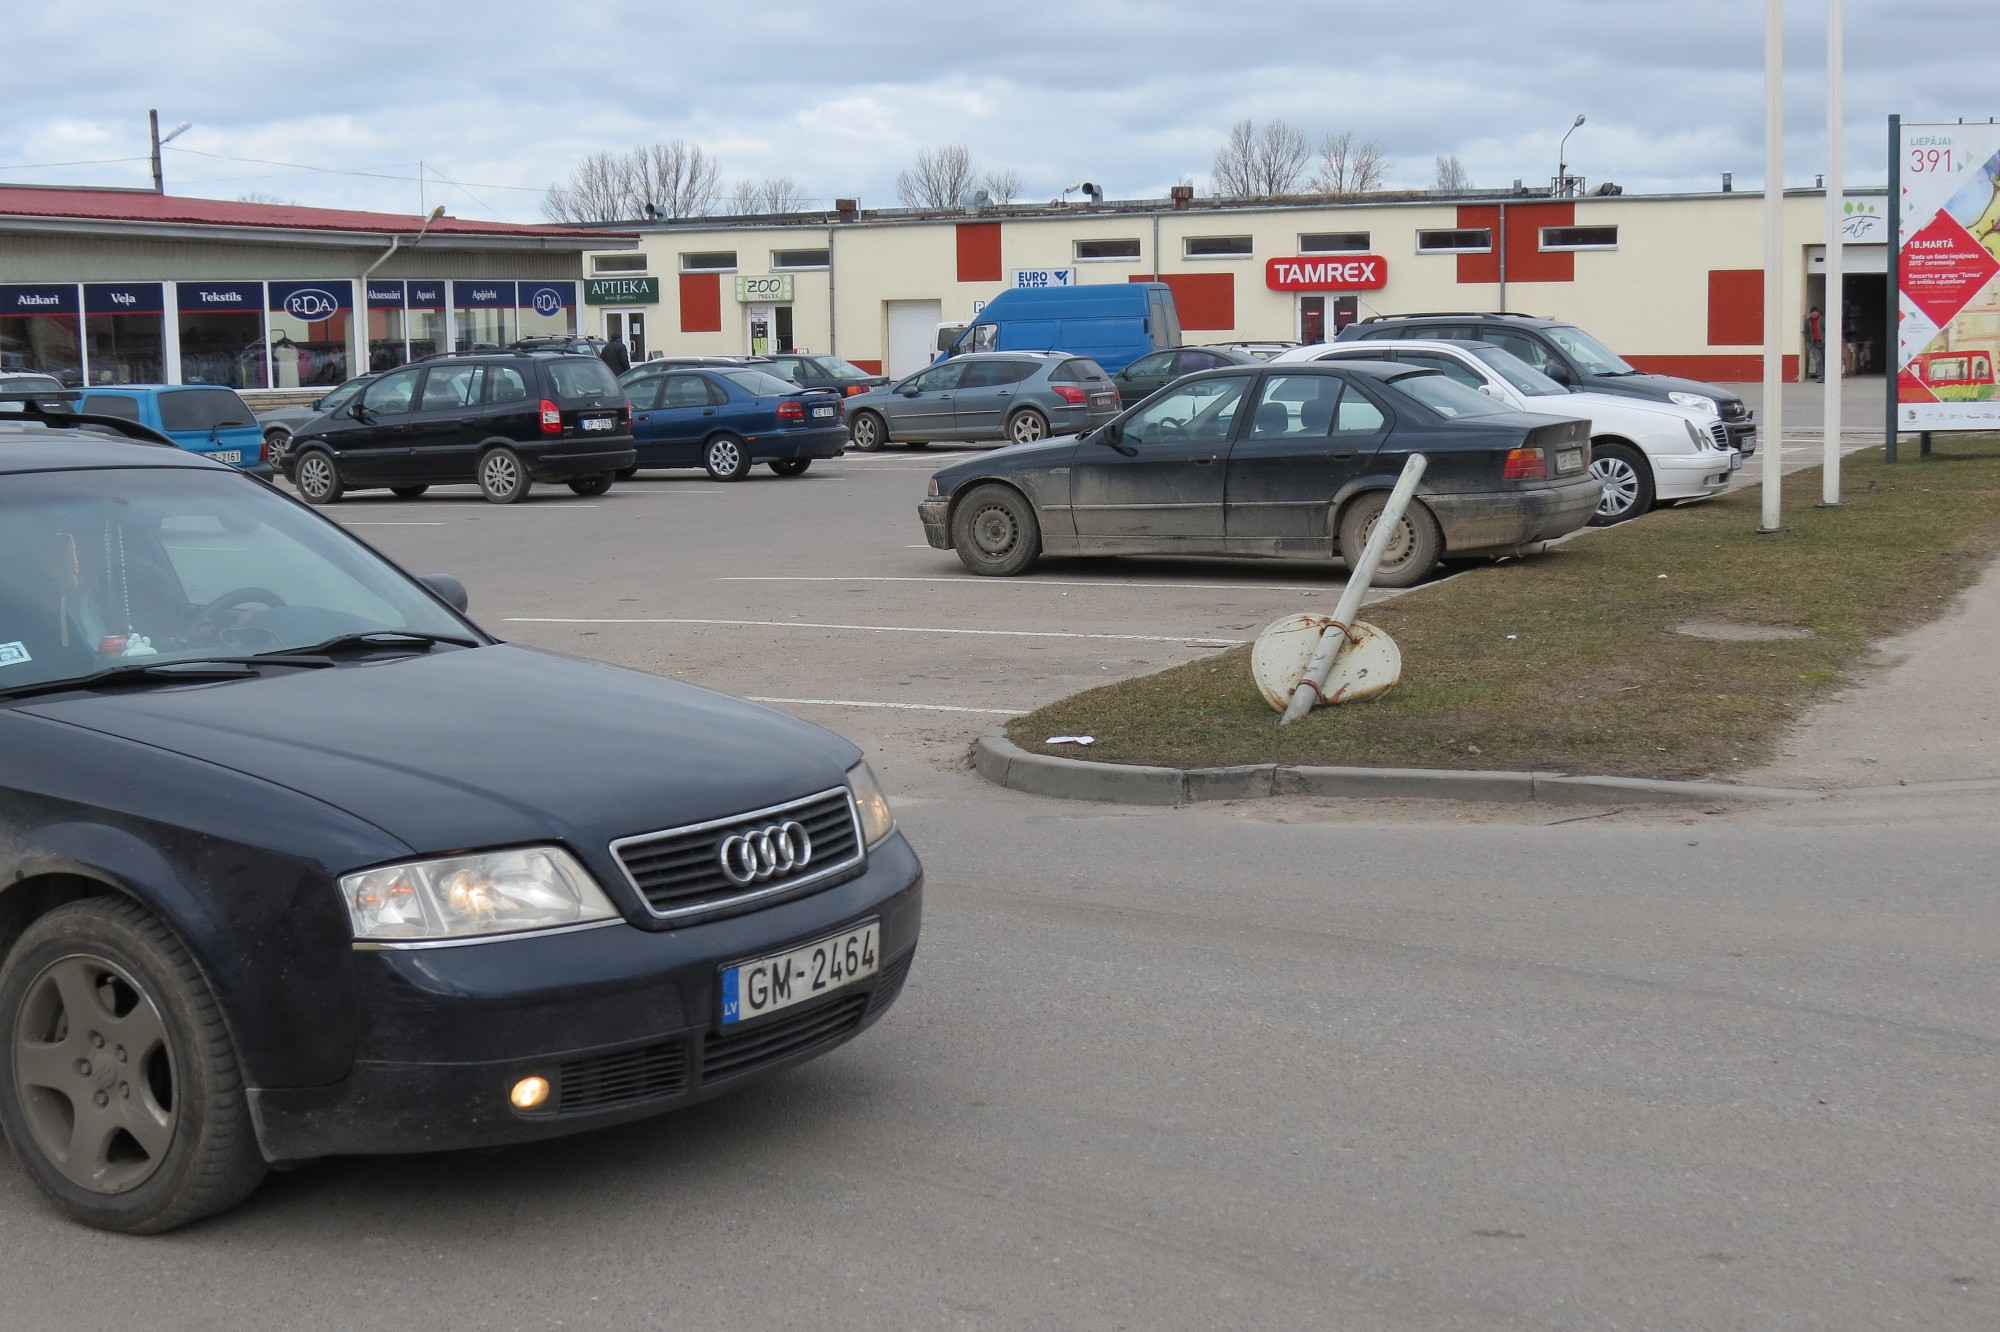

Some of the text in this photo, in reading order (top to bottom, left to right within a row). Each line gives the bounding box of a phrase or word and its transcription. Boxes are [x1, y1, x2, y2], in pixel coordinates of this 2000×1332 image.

[1910, 136, 1951, 145] LIEPĀJAI
[1911, 149, 1951, 172] 391
[1909, 239, 1954, 249] 18.MARTĀ
[1018, 272, 1048, 281] EURO
[1274, 262, 1376, 284] TAMREX
[591, 280, 650, 295] APTIEKA
[747, 279, 781, 293] ZOO
[17, 295, 59, 305] Aizkari
[111, 293, 136, 306] Veļa
[200, 292, 242, 302] Tekstils
[367, 290, 400, 299] Aksesuāri
[416, 290, 436, 301] Apavi
[472, 289, 497, 300] Apģērbi
[748, 930, 875, 1010] GM-2464
[724, 1001, 738, 1016] LV
